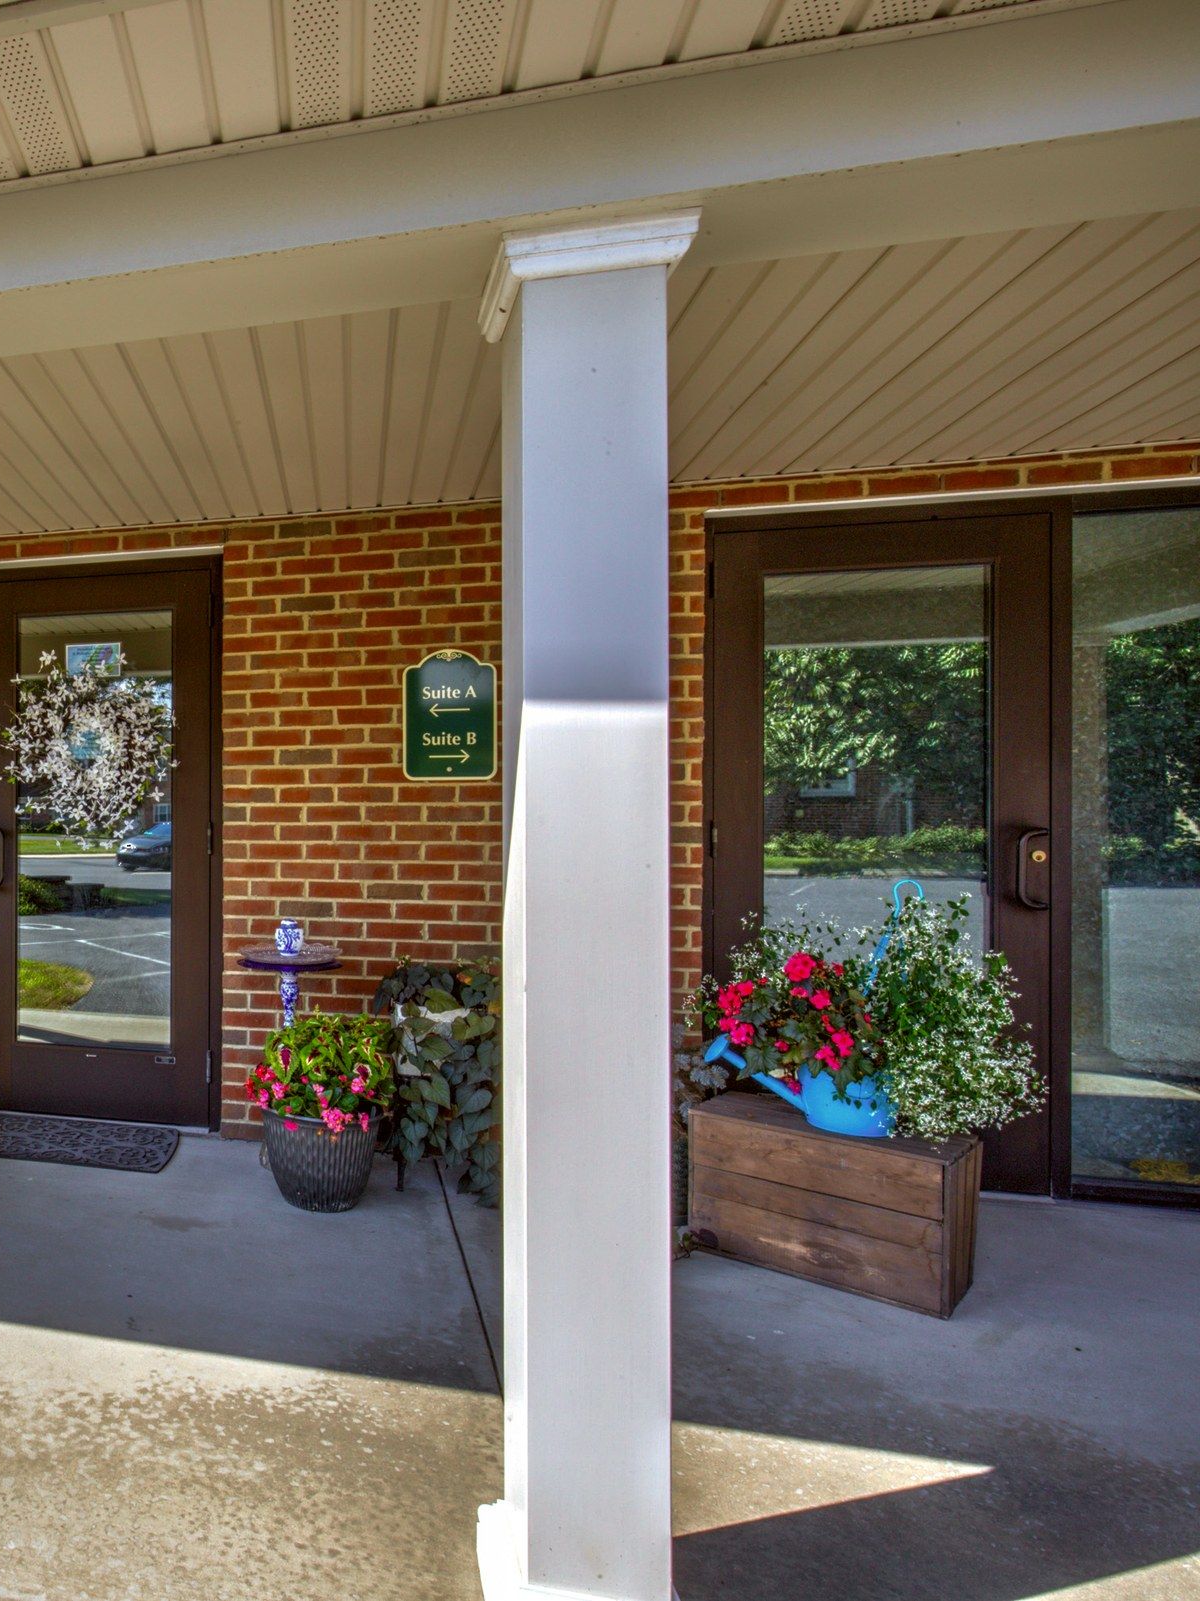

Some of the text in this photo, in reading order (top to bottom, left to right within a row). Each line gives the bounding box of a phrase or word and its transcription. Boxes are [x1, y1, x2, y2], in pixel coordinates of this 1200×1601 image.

[422, 685, 477, 700] Suite A
[422, 731, 477, 746] Suite B
